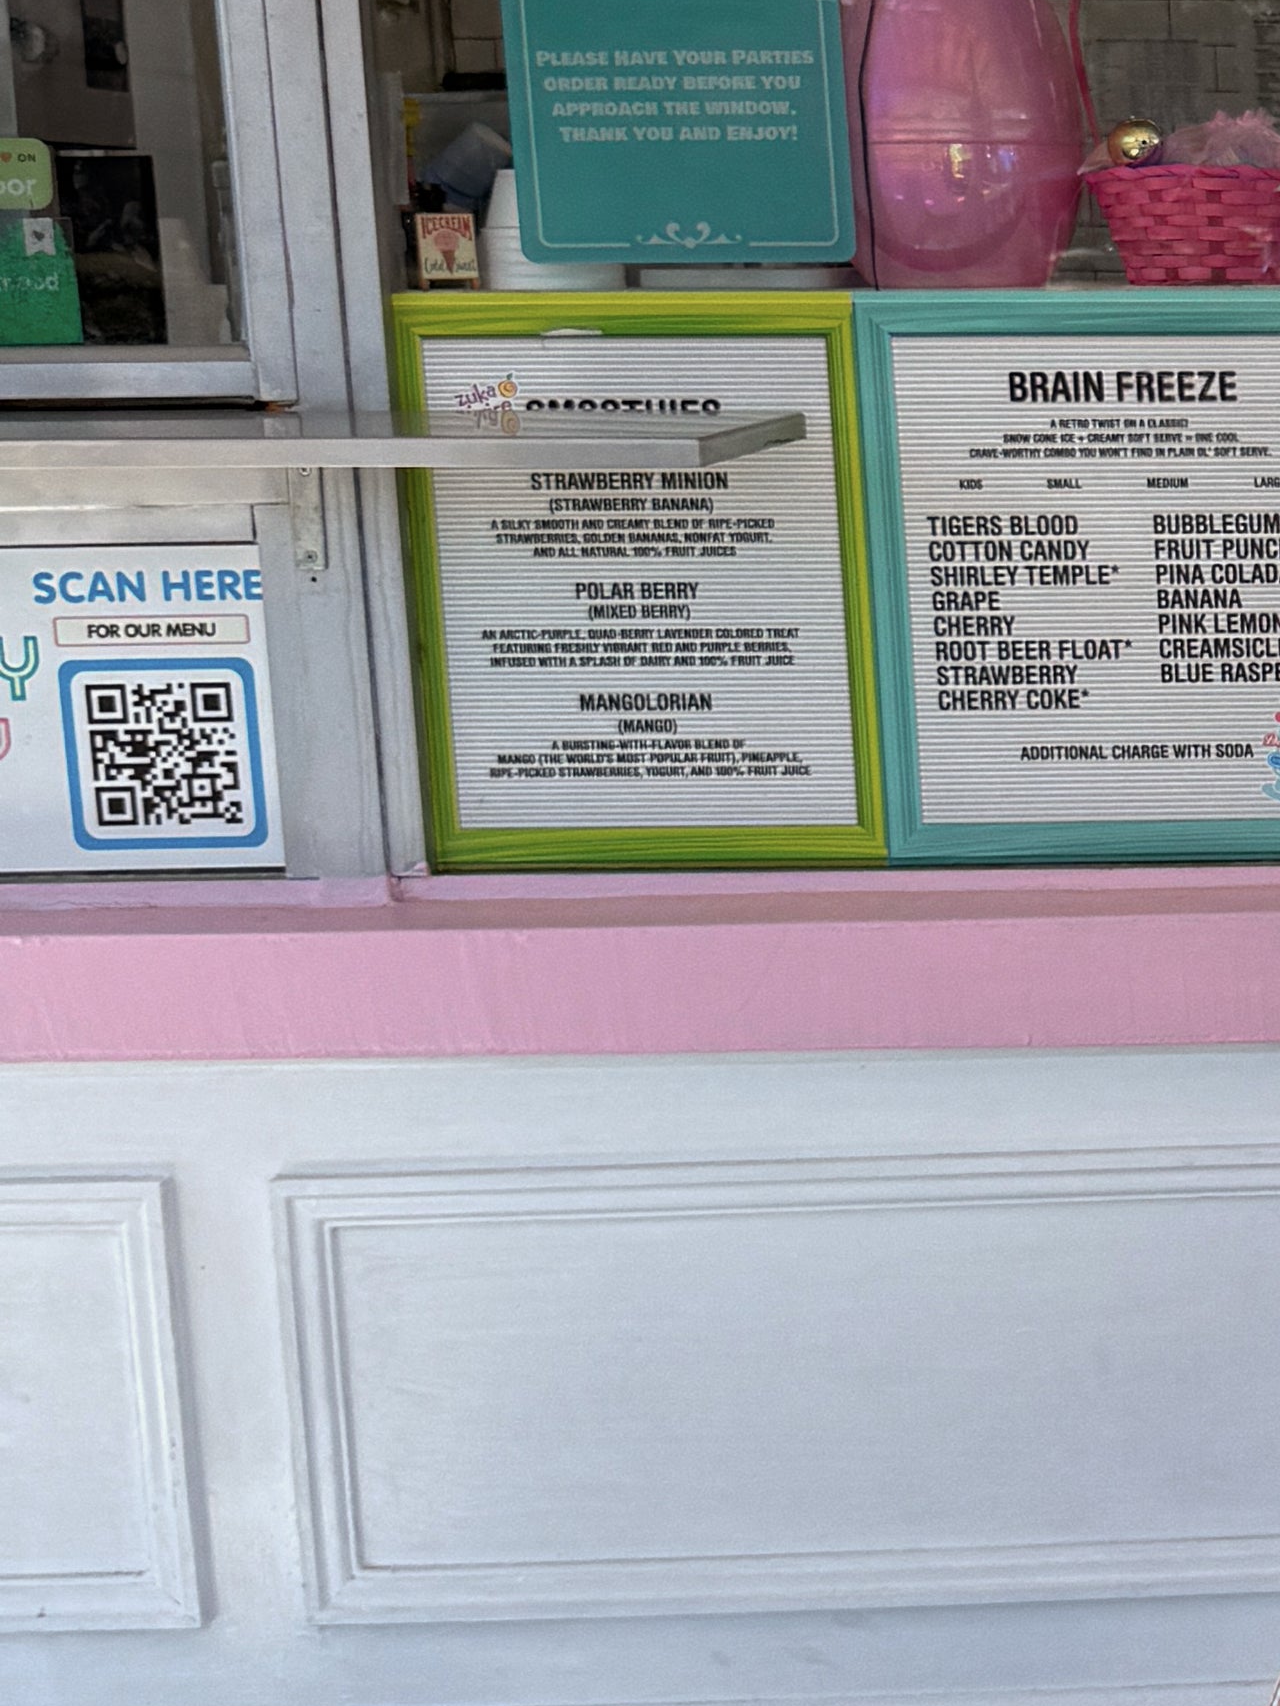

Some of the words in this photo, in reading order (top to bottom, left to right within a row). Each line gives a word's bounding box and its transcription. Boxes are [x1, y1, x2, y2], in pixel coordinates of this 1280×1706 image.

[17, 153, 36, 162] ON
[1008, 371, 1105, 403] BRAIN
[1116, 370, 1238, 403] FREEZE
[530, 472, 654, 491] STRAWBERRY
[661, 472, 729, 490] MINION
[959, 479, 983, 490] KIDS
[1047, 478, 1082, 489] SMALL
[1147, 477, 1189, 488] MEDIUM
[549, 497, 648, 514] (STRAWBERRY
[652, 497, 714, 514] BANANA)
[927, 516, 1002, 535] TIGERS
[1010, 516, 1079, 535] BLOOD
[1153, 514, 1280, 534] BUBBLEGUM
[929, 541, 1012, 562] COTTON
[1020, 540, 1090, 561] CANDY
[1155, 565, 1204, 584] PINA
[32, 571, 146, 604] SCAN
[161, 570, 263, 601] HERE
[575, 582, 636, 600] POLAR
[641, 582, 699, 600] BERRY
[87, 624, 120, 638] FOR
[125, 624, 162, 638] OUR
[167, 623, 216, 637] MENU
[1161, 663, 1214, 684] BLUE
[580, 694, 713, 712] MANGOLORIAN
[618, 718, 678, 735] (MANGO)
